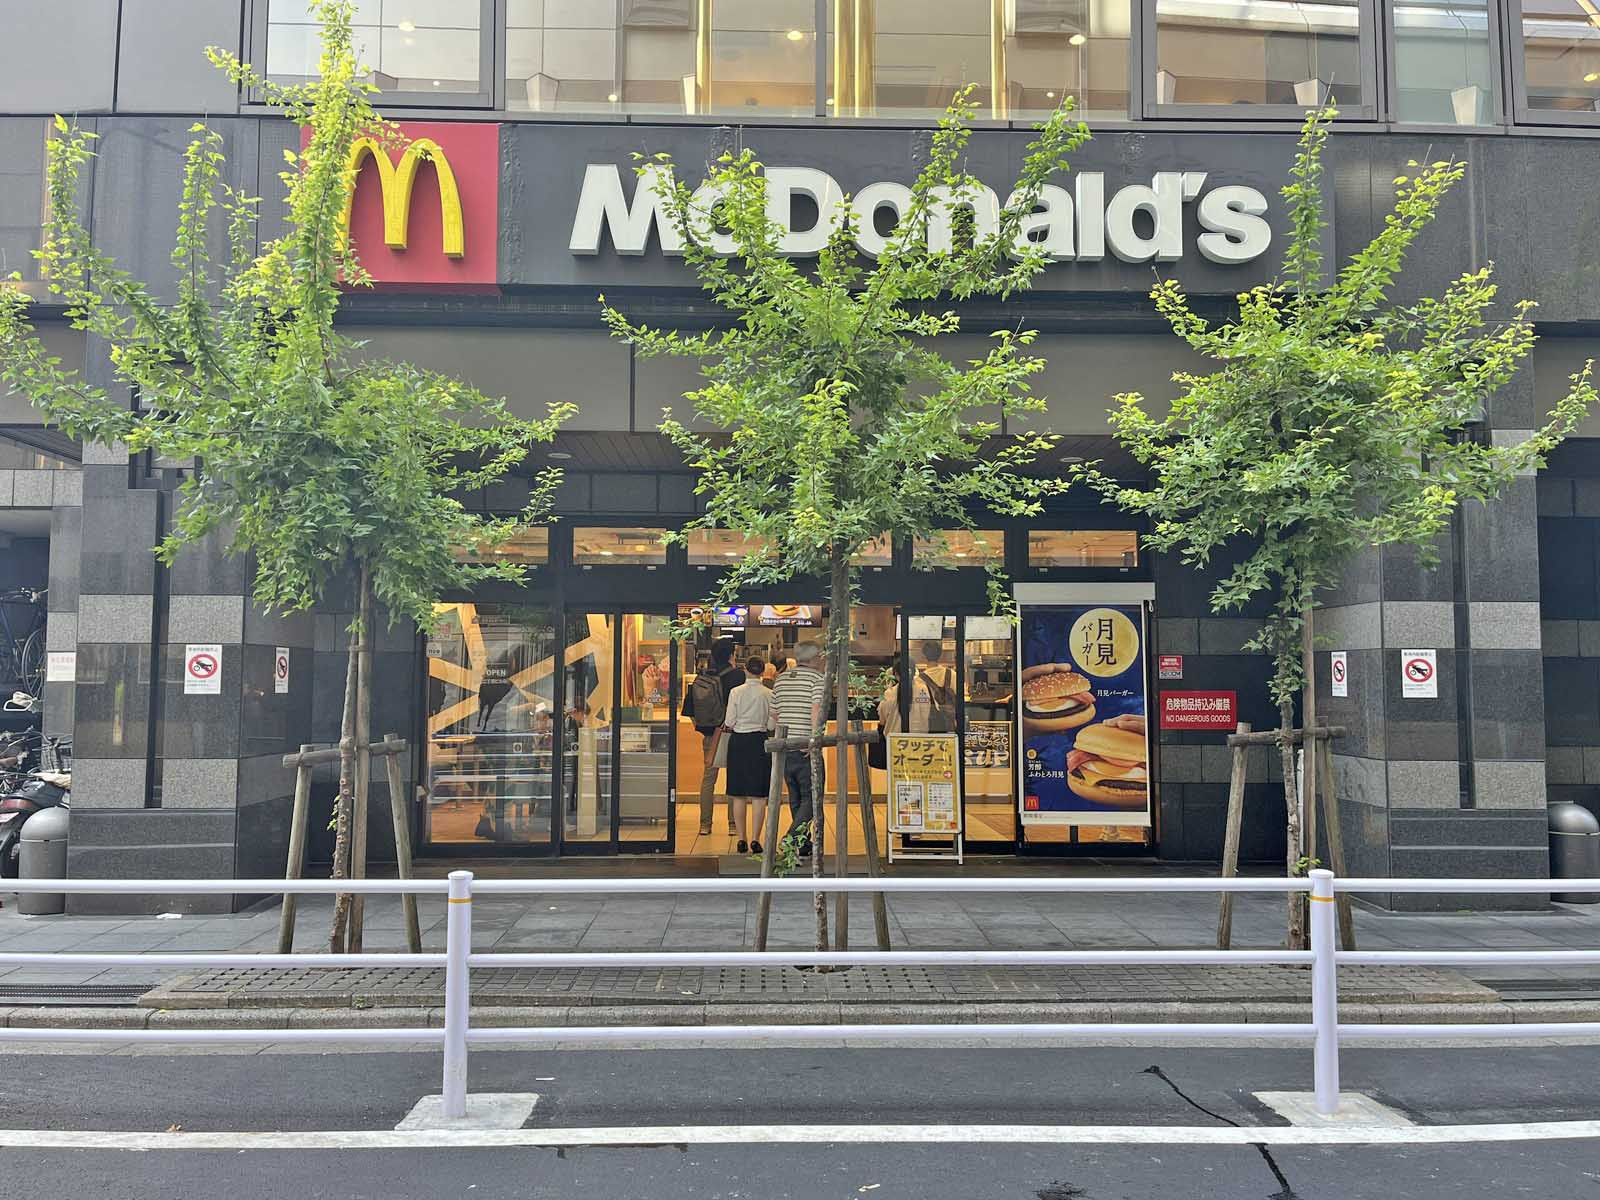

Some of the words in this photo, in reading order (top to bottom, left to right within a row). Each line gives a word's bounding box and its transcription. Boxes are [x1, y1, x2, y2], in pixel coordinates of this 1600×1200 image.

[568, 163, 1272, 264] McDonald's
[1081, 622, 1093, 666] バーガー
[1095, 618, 1117, 666] 月見
[1166, 697, 1231, 711] 危険物品持込み厳禁
[1166, 714, 1174, 722] NO
[1175, 714, 1209, 722] DANGEROUS
[1210, 714, 1231, 722] GOODS
[897, 739, 949, 752] タッチで
